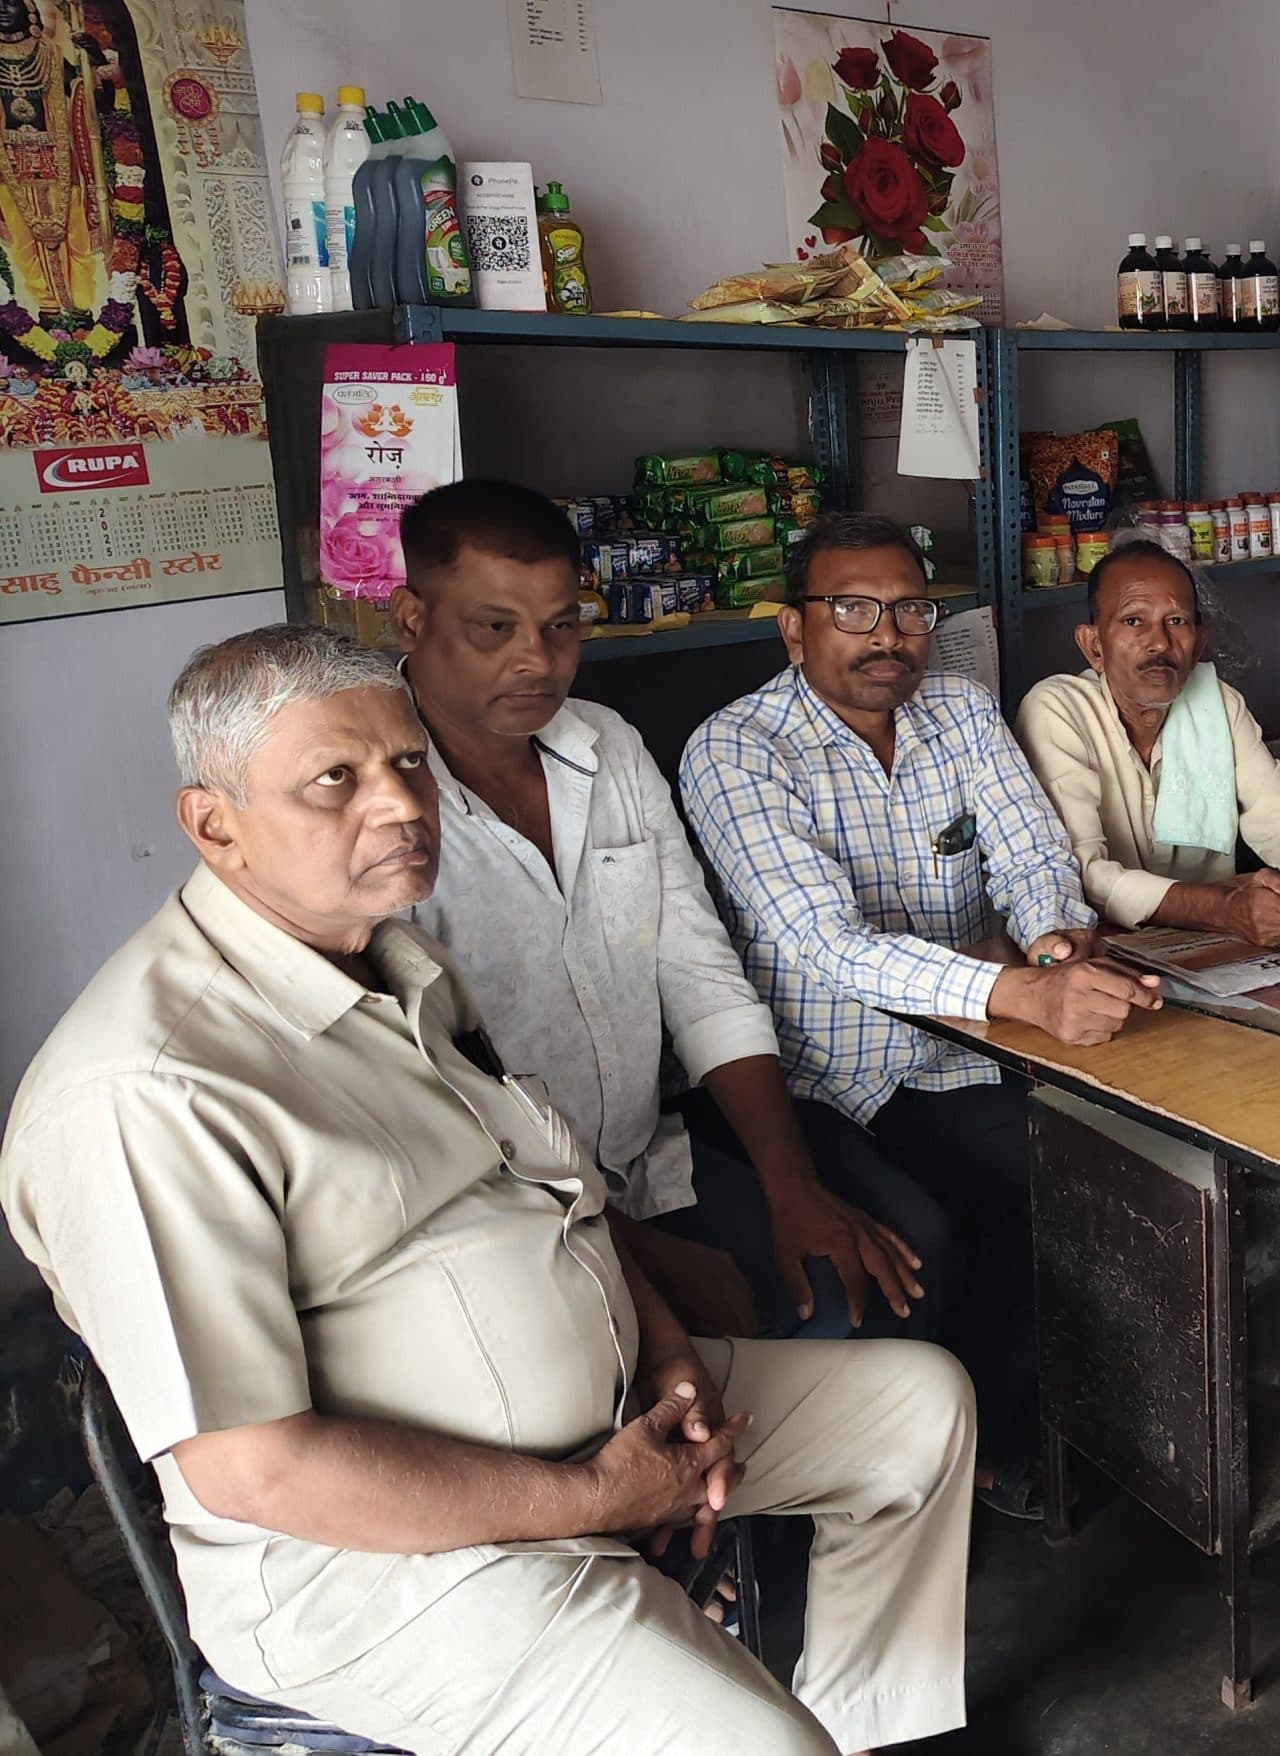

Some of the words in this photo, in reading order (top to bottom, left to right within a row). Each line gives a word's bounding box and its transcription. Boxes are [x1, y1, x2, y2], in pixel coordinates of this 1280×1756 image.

[428, 206, 454, 232] GREEN
[334, 371, 360, 381] SUPER
[362, 371, 388, 381] SAVER
[391, 372, 412, 382] PACK
[67, 454, 139, 473] RUPA
[364, 440, 405, 469] रोज़
[1061, 496, 1105, 509] Navratan
[1068, 509, 1104, 521] Mixture
[69, 558, 152, 585] फैन्सी
[160, 551, 222, 576] स्टोर
